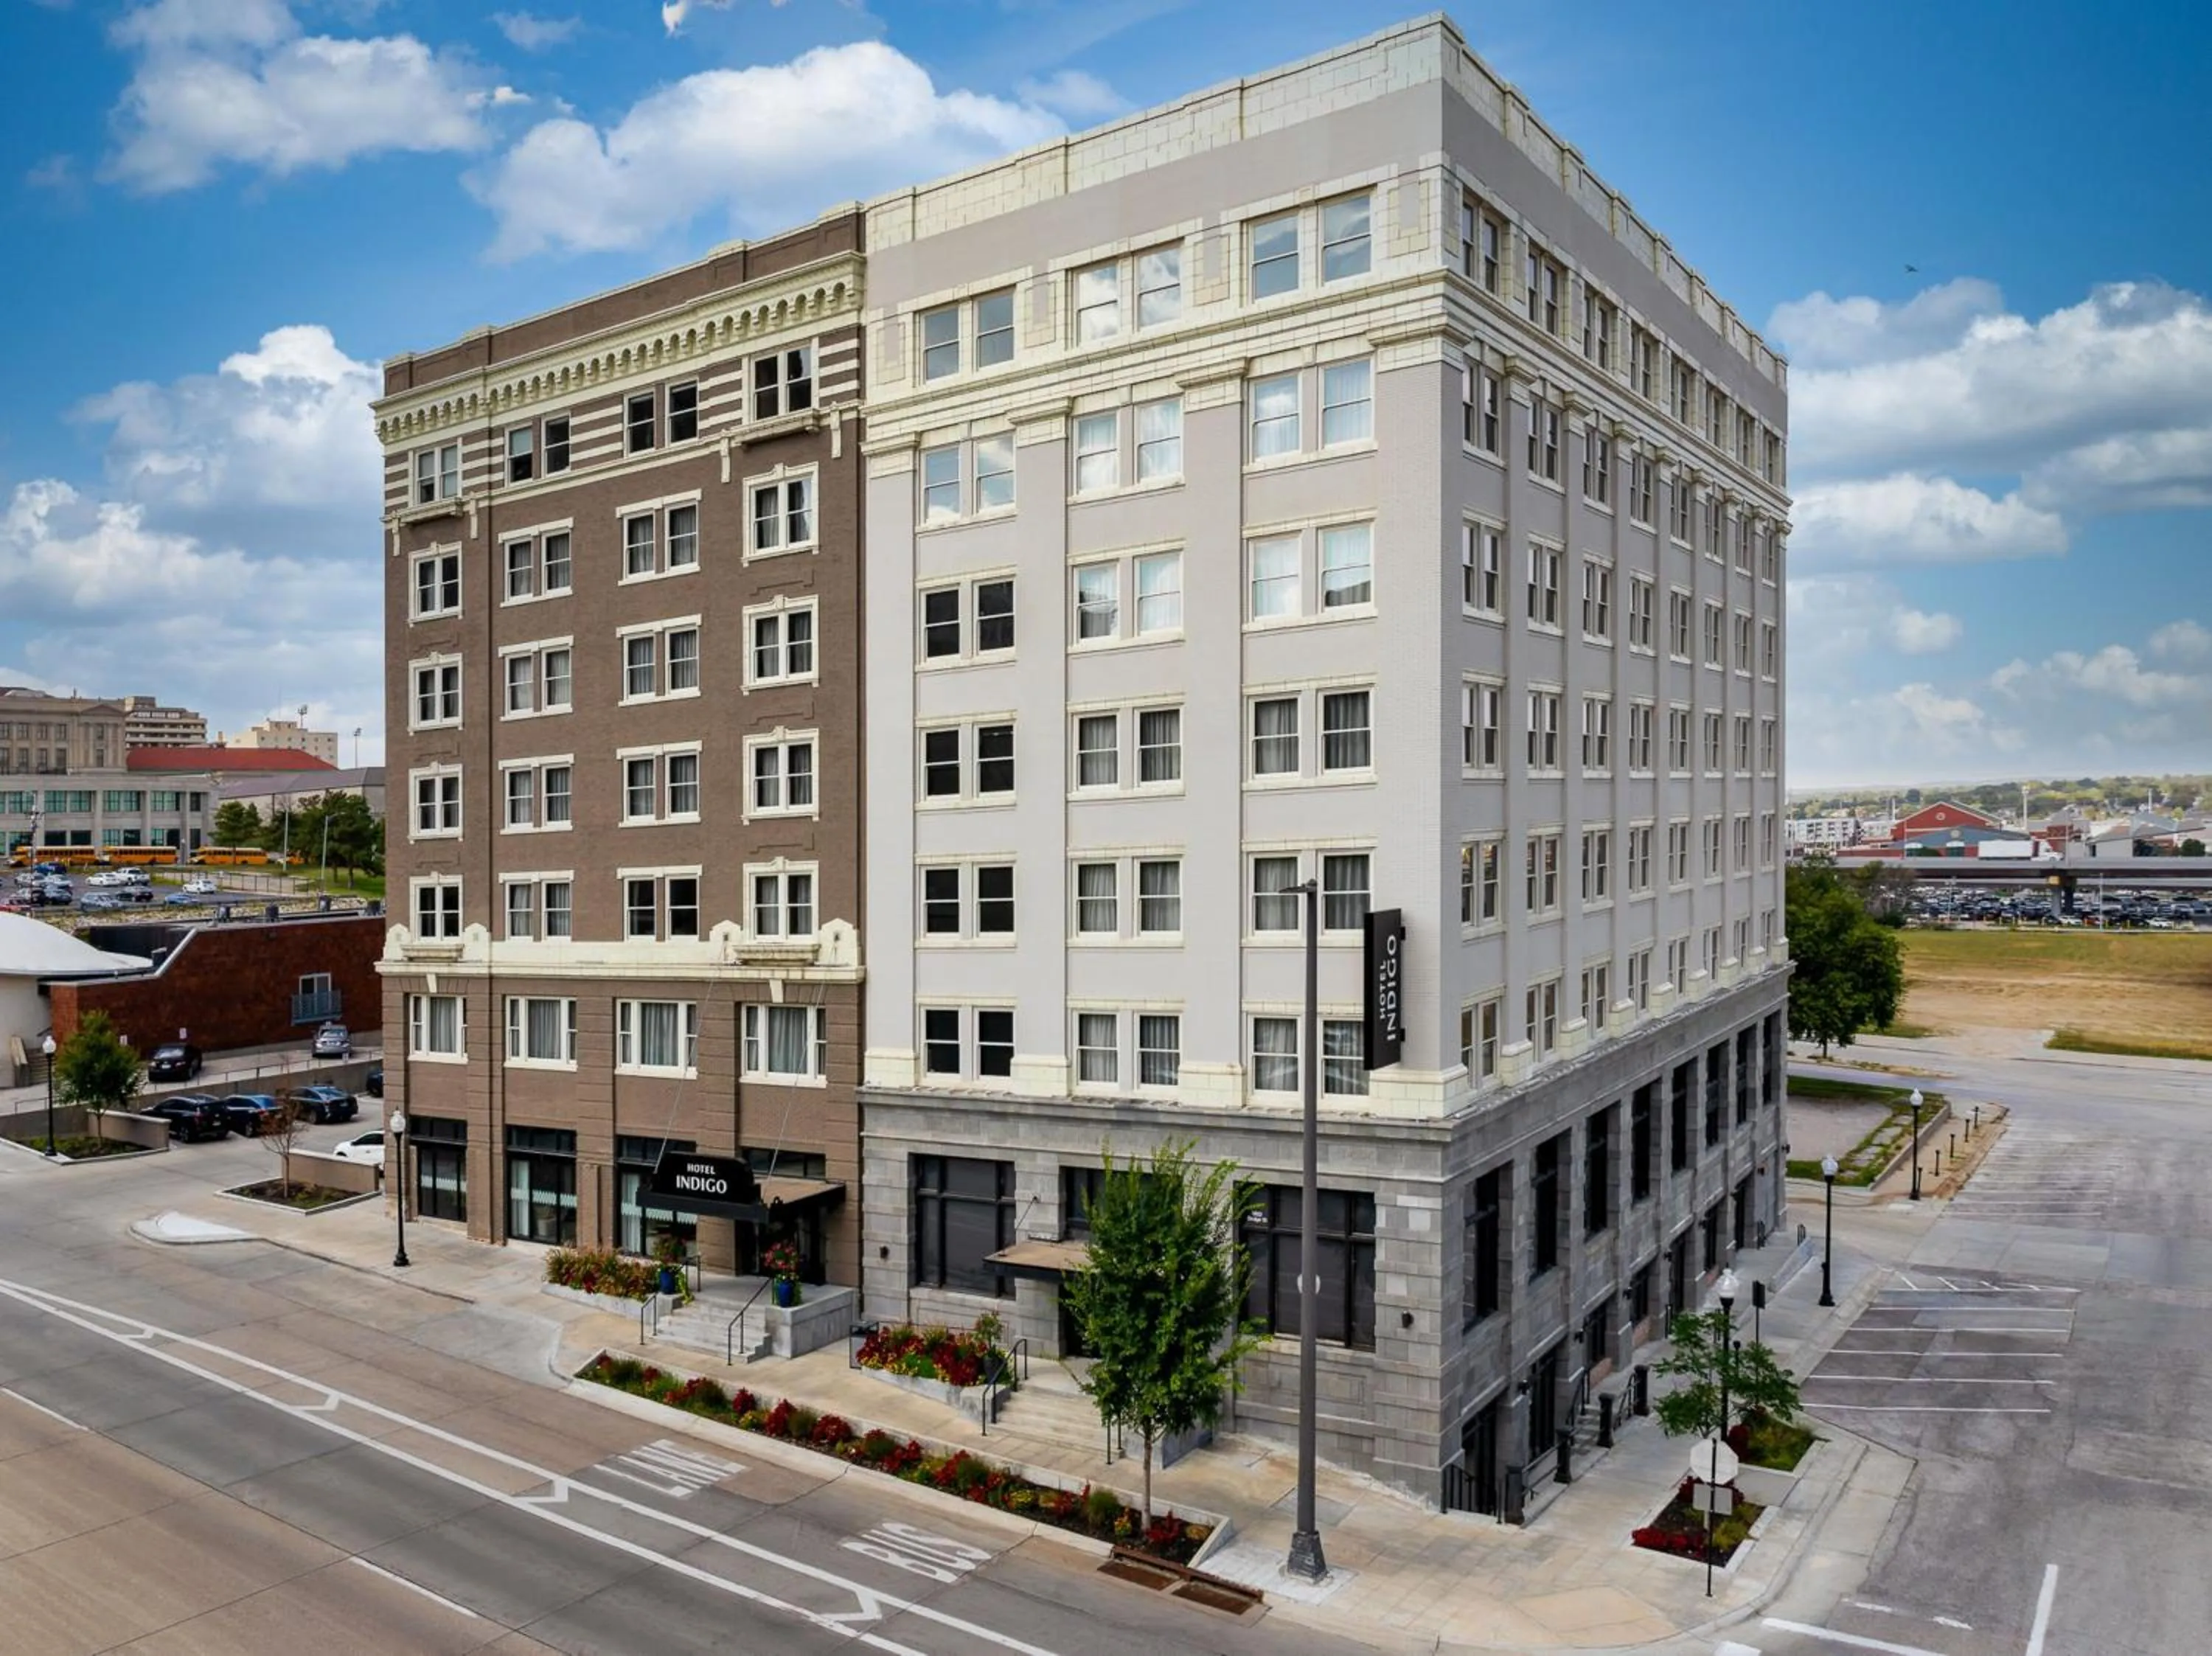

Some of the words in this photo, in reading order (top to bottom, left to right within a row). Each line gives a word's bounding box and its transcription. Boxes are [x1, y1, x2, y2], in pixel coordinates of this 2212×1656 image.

[1387, 934, 1397, 1041] INDIGO
[676, 1175, 728, 1194] INDIGO
[687, 1163, 716, 1175] HOTEL
[594, 1439, 747, 1497] LANE
[841, 1523, 991, 1583] BUS
